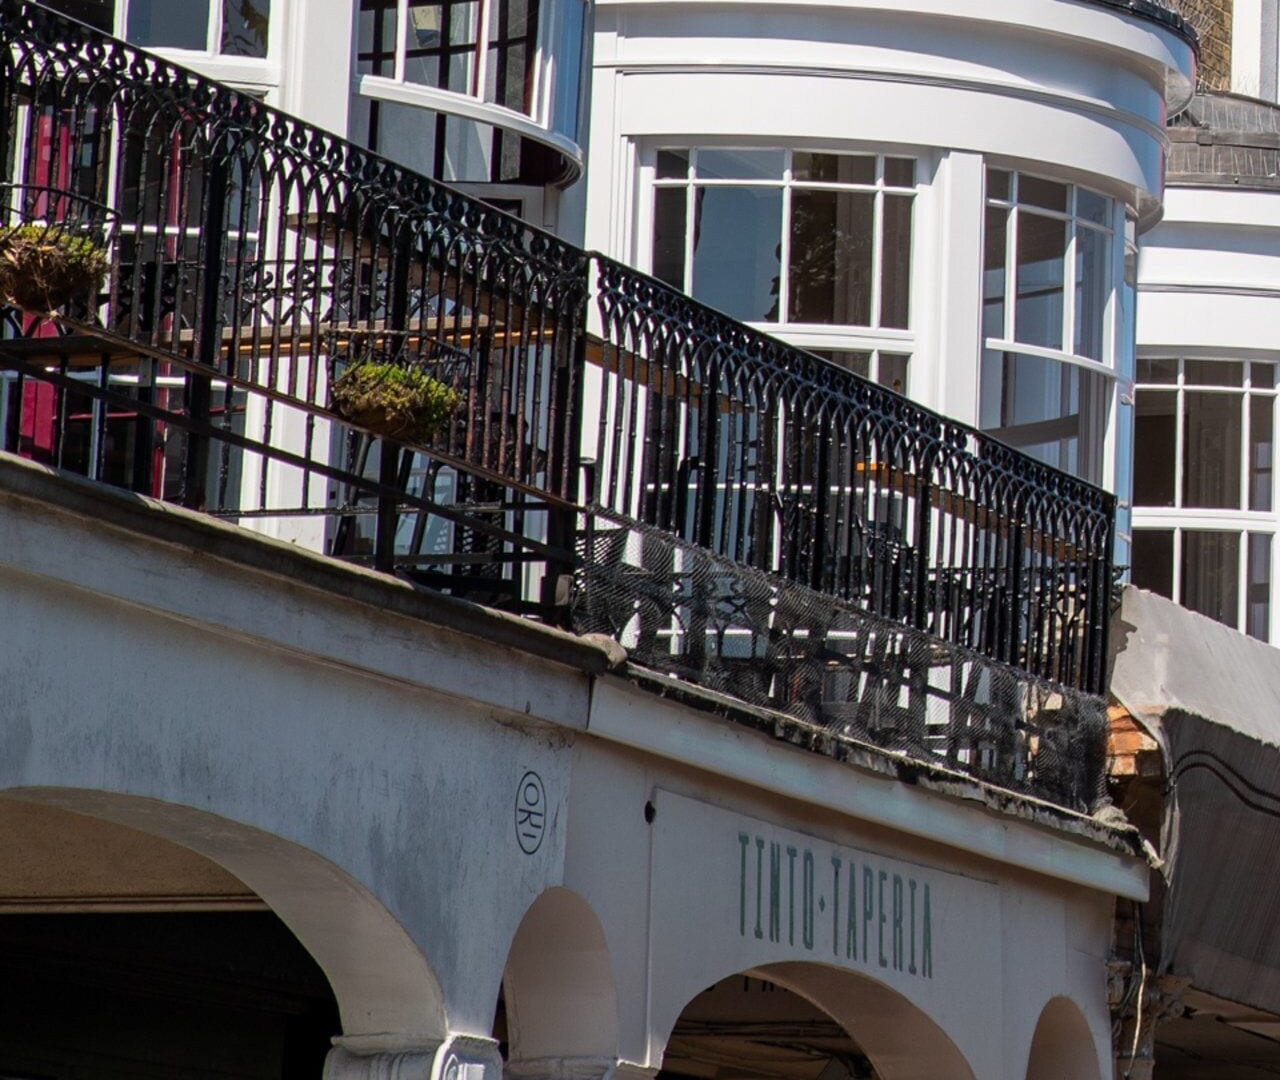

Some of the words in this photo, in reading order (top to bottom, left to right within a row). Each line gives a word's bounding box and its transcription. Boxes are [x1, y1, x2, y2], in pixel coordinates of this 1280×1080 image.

[518, 781, 543, 839] OKI
[737, 831, 814, 951] TINTO
[830, 855, 933, 980] TAPERIA
